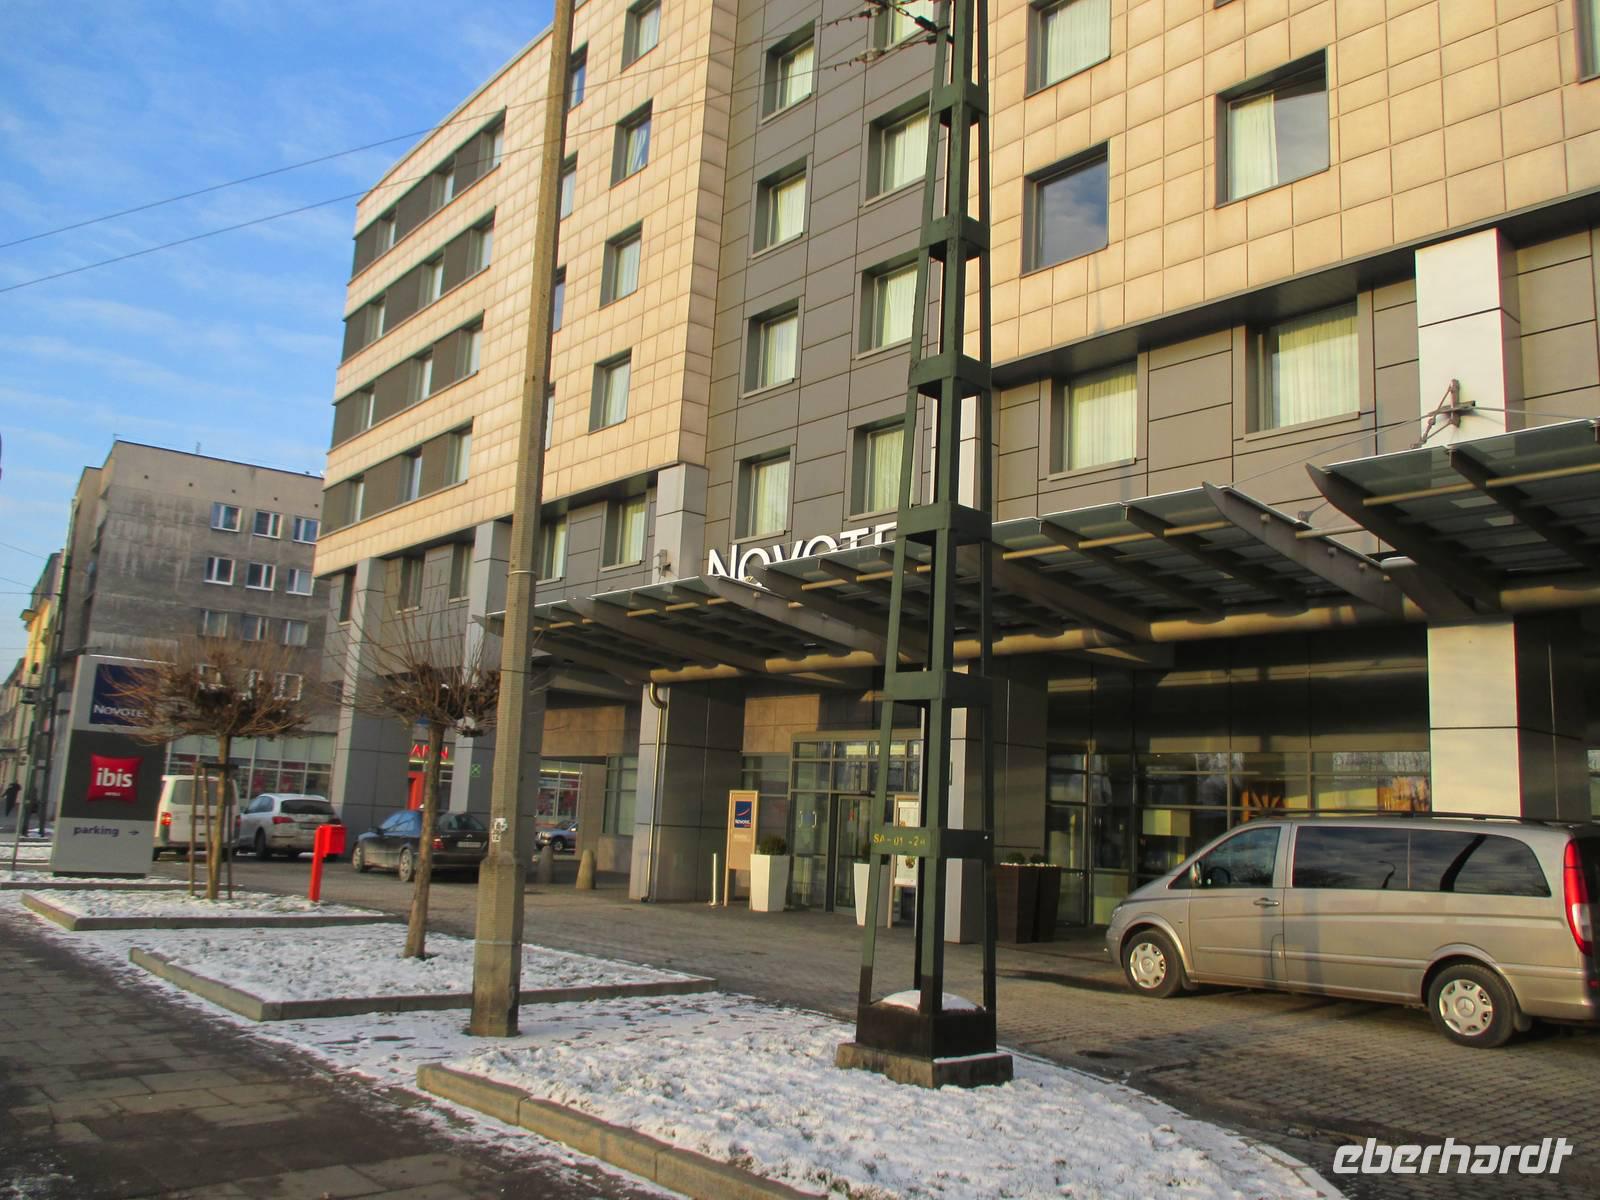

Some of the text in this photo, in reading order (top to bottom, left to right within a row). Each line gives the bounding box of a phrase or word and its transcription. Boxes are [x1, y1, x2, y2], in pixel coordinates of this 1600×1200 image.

[708, 521, 897, 586] NOVOTE
[96, 768, 133, 787] ibis
[73, 826, 120, 838] parking
